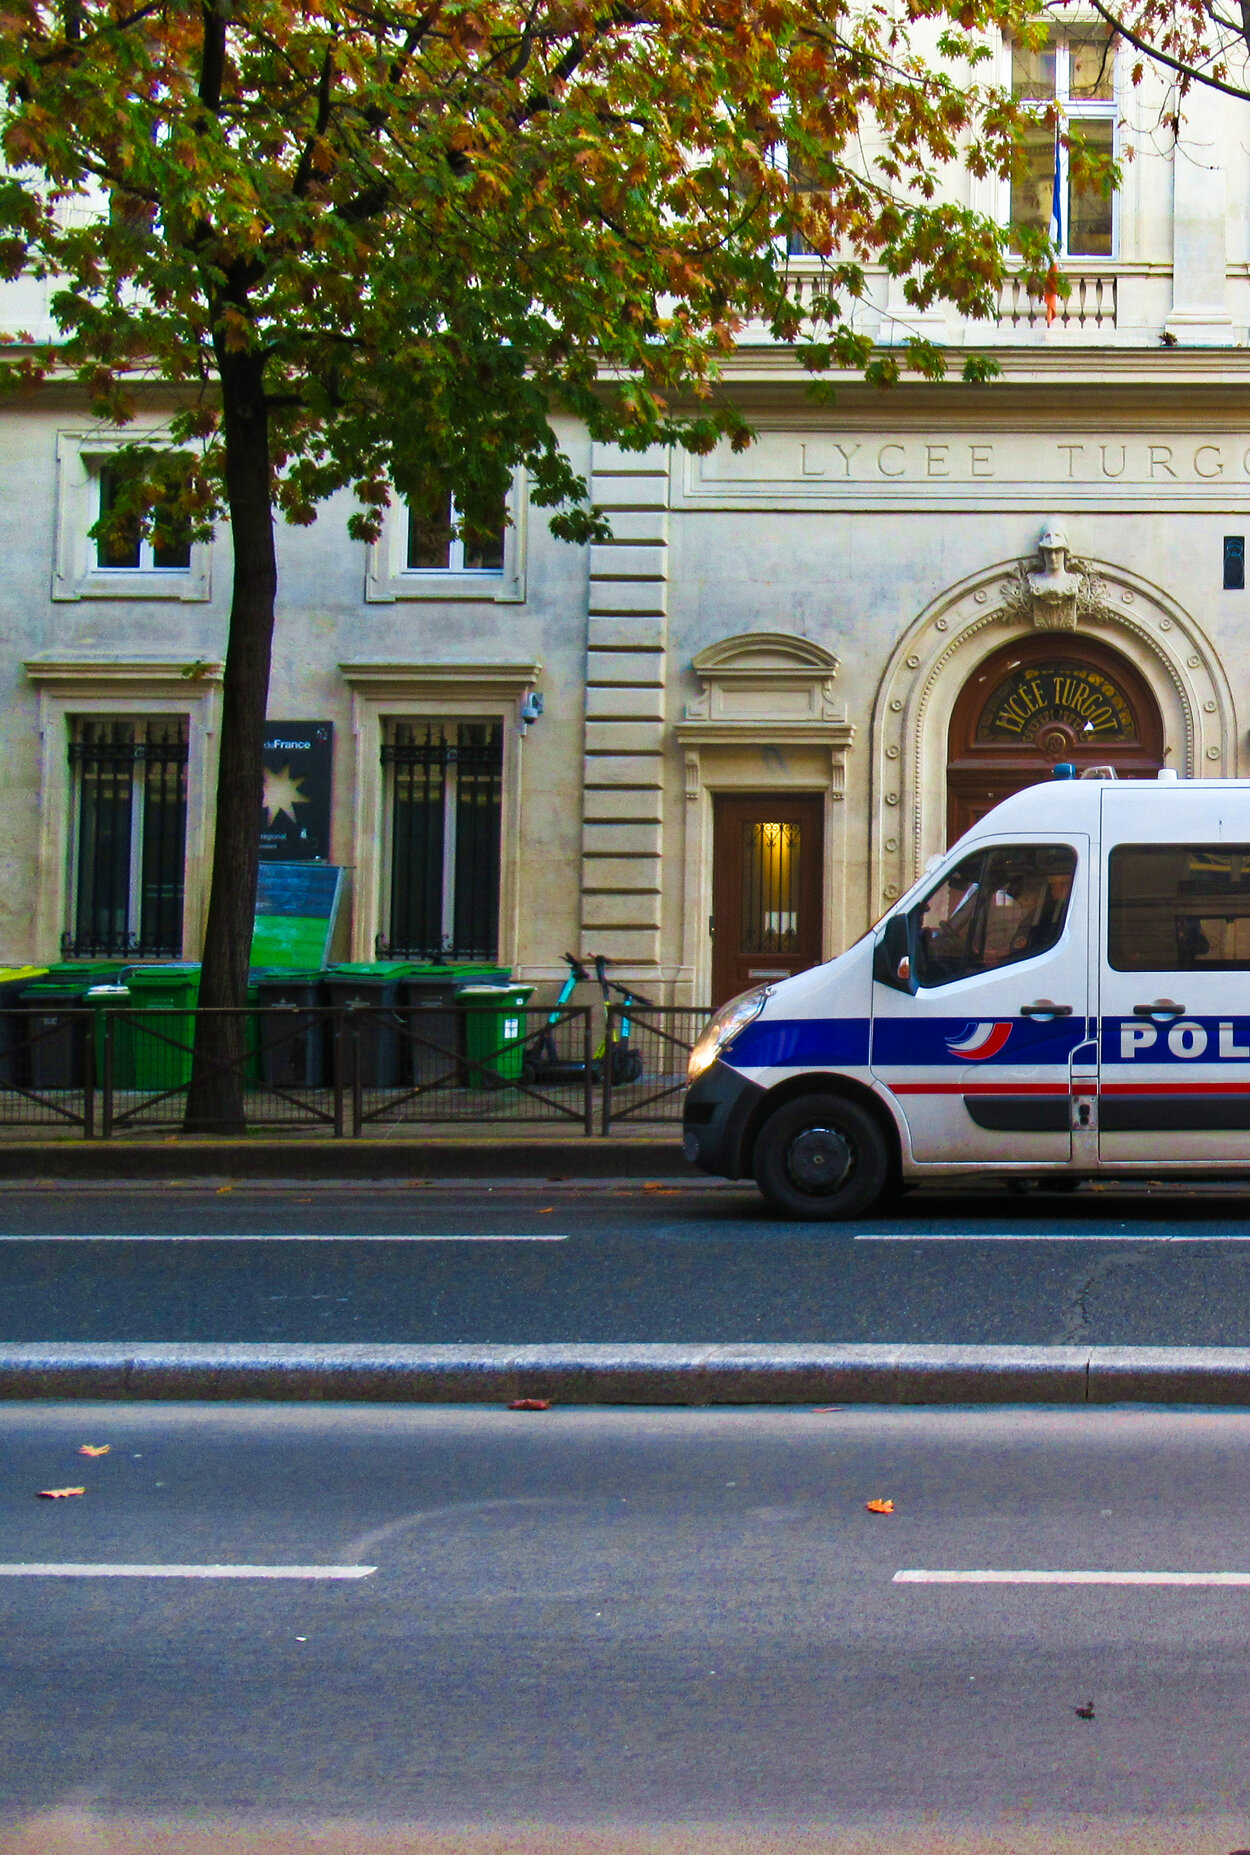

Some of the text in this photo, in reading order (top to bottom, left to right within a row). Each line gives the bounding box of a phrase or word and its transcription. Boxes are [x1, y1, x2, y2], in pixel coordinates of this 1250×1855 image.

[801, 443, 995, 478] LYCEE
[995, 677, 1119, 733] LYCÉE TURGOT
